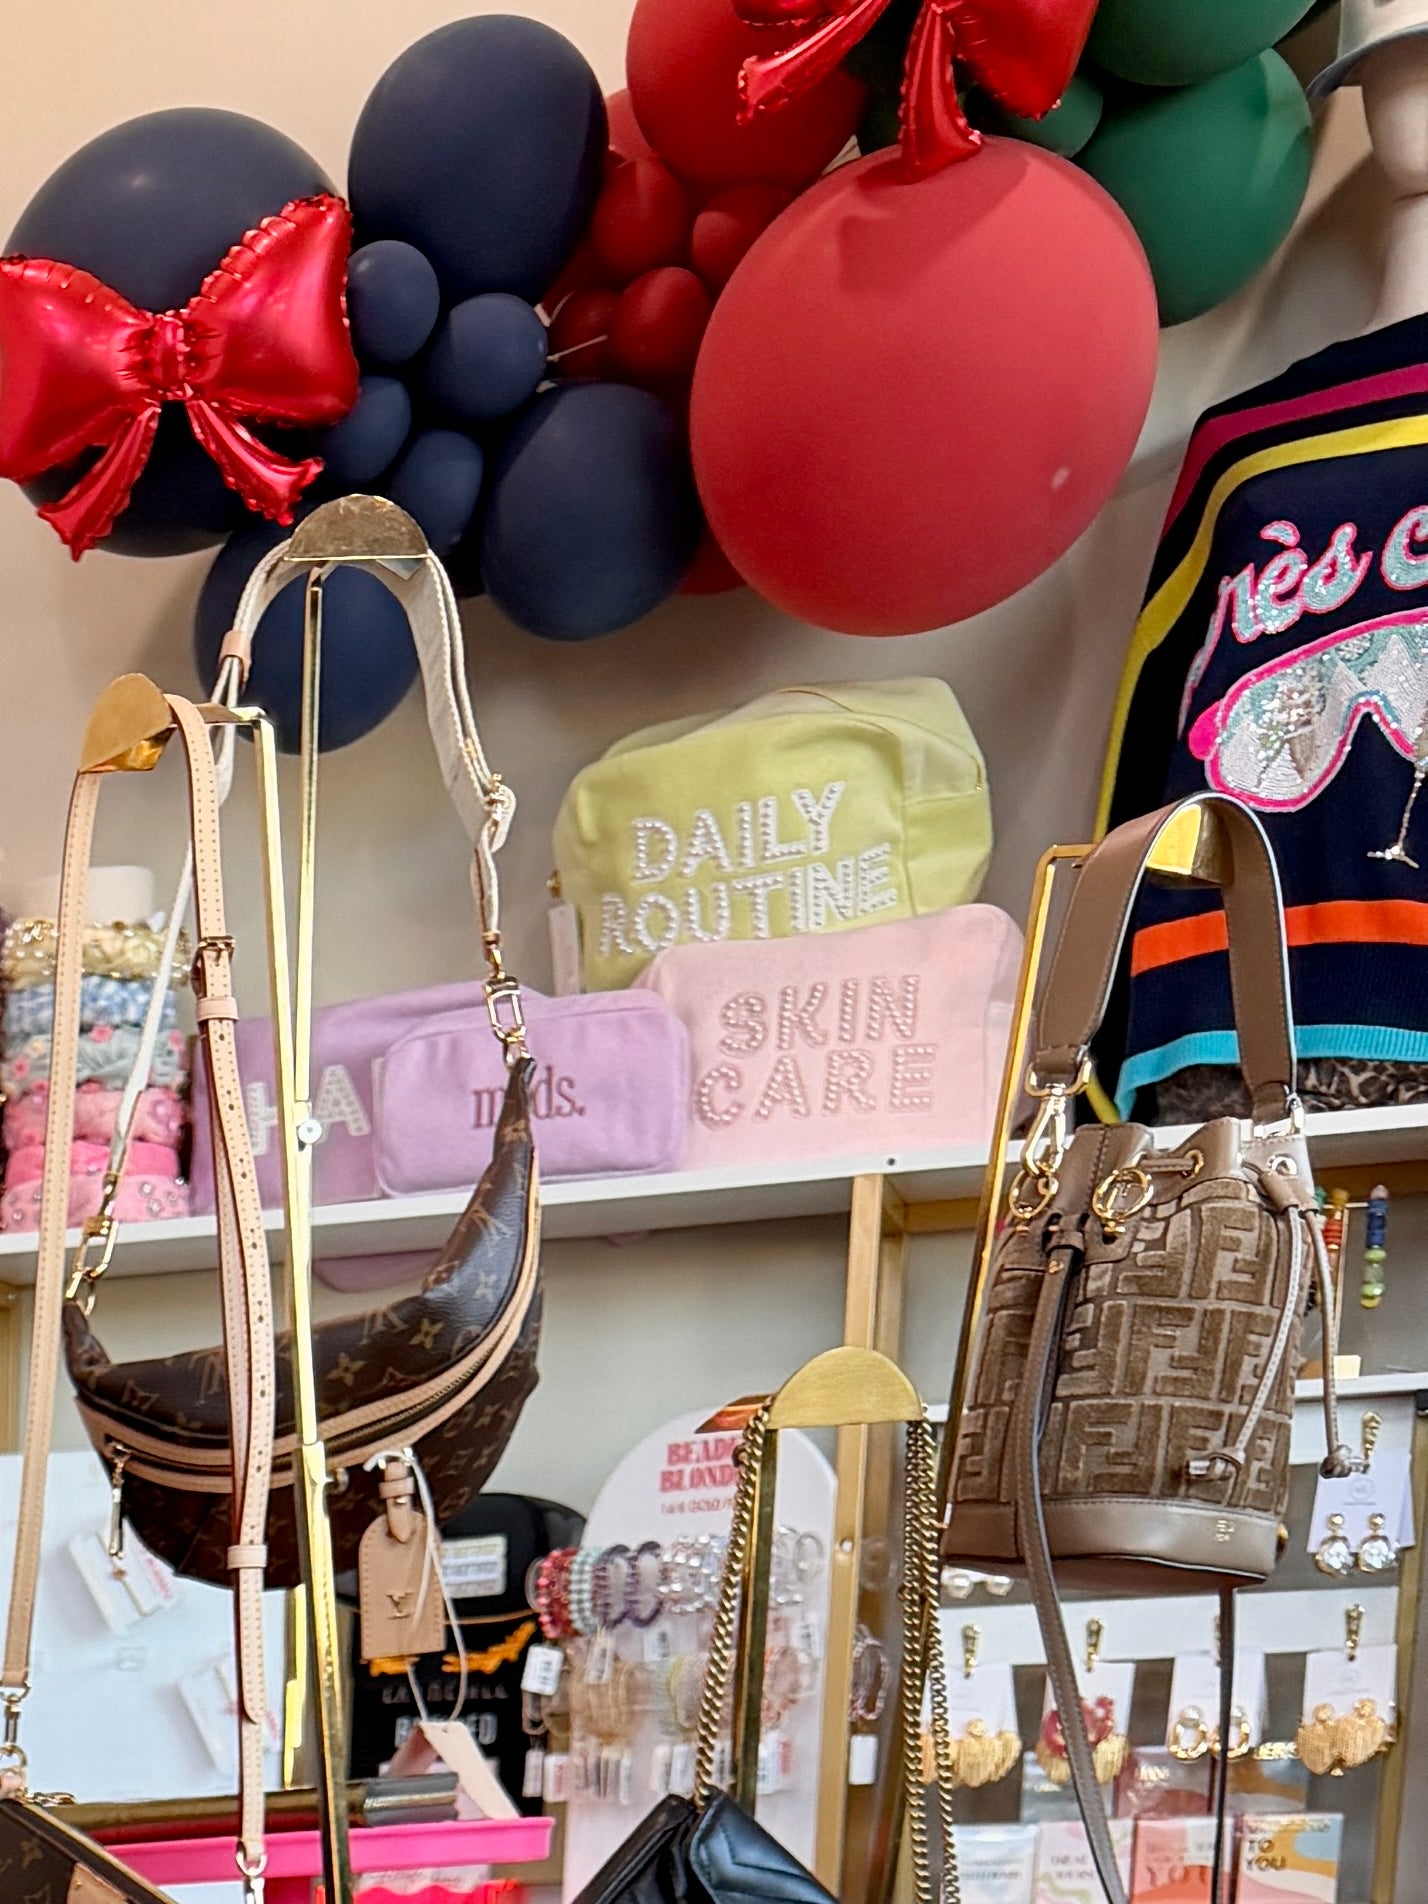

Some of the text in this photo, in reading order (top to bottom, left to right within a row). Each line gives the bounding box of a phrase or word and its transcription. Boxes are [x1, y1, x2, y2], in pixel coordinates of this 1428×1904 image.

[631, 782, 844, 886] DAILY
[599, 842, 898, 957] ROUTINE
[717, 974, 910, 1059] SKIN
[472, 1065, 587, 1130] mds.
[695, 1044, 938, 1131] CARE
